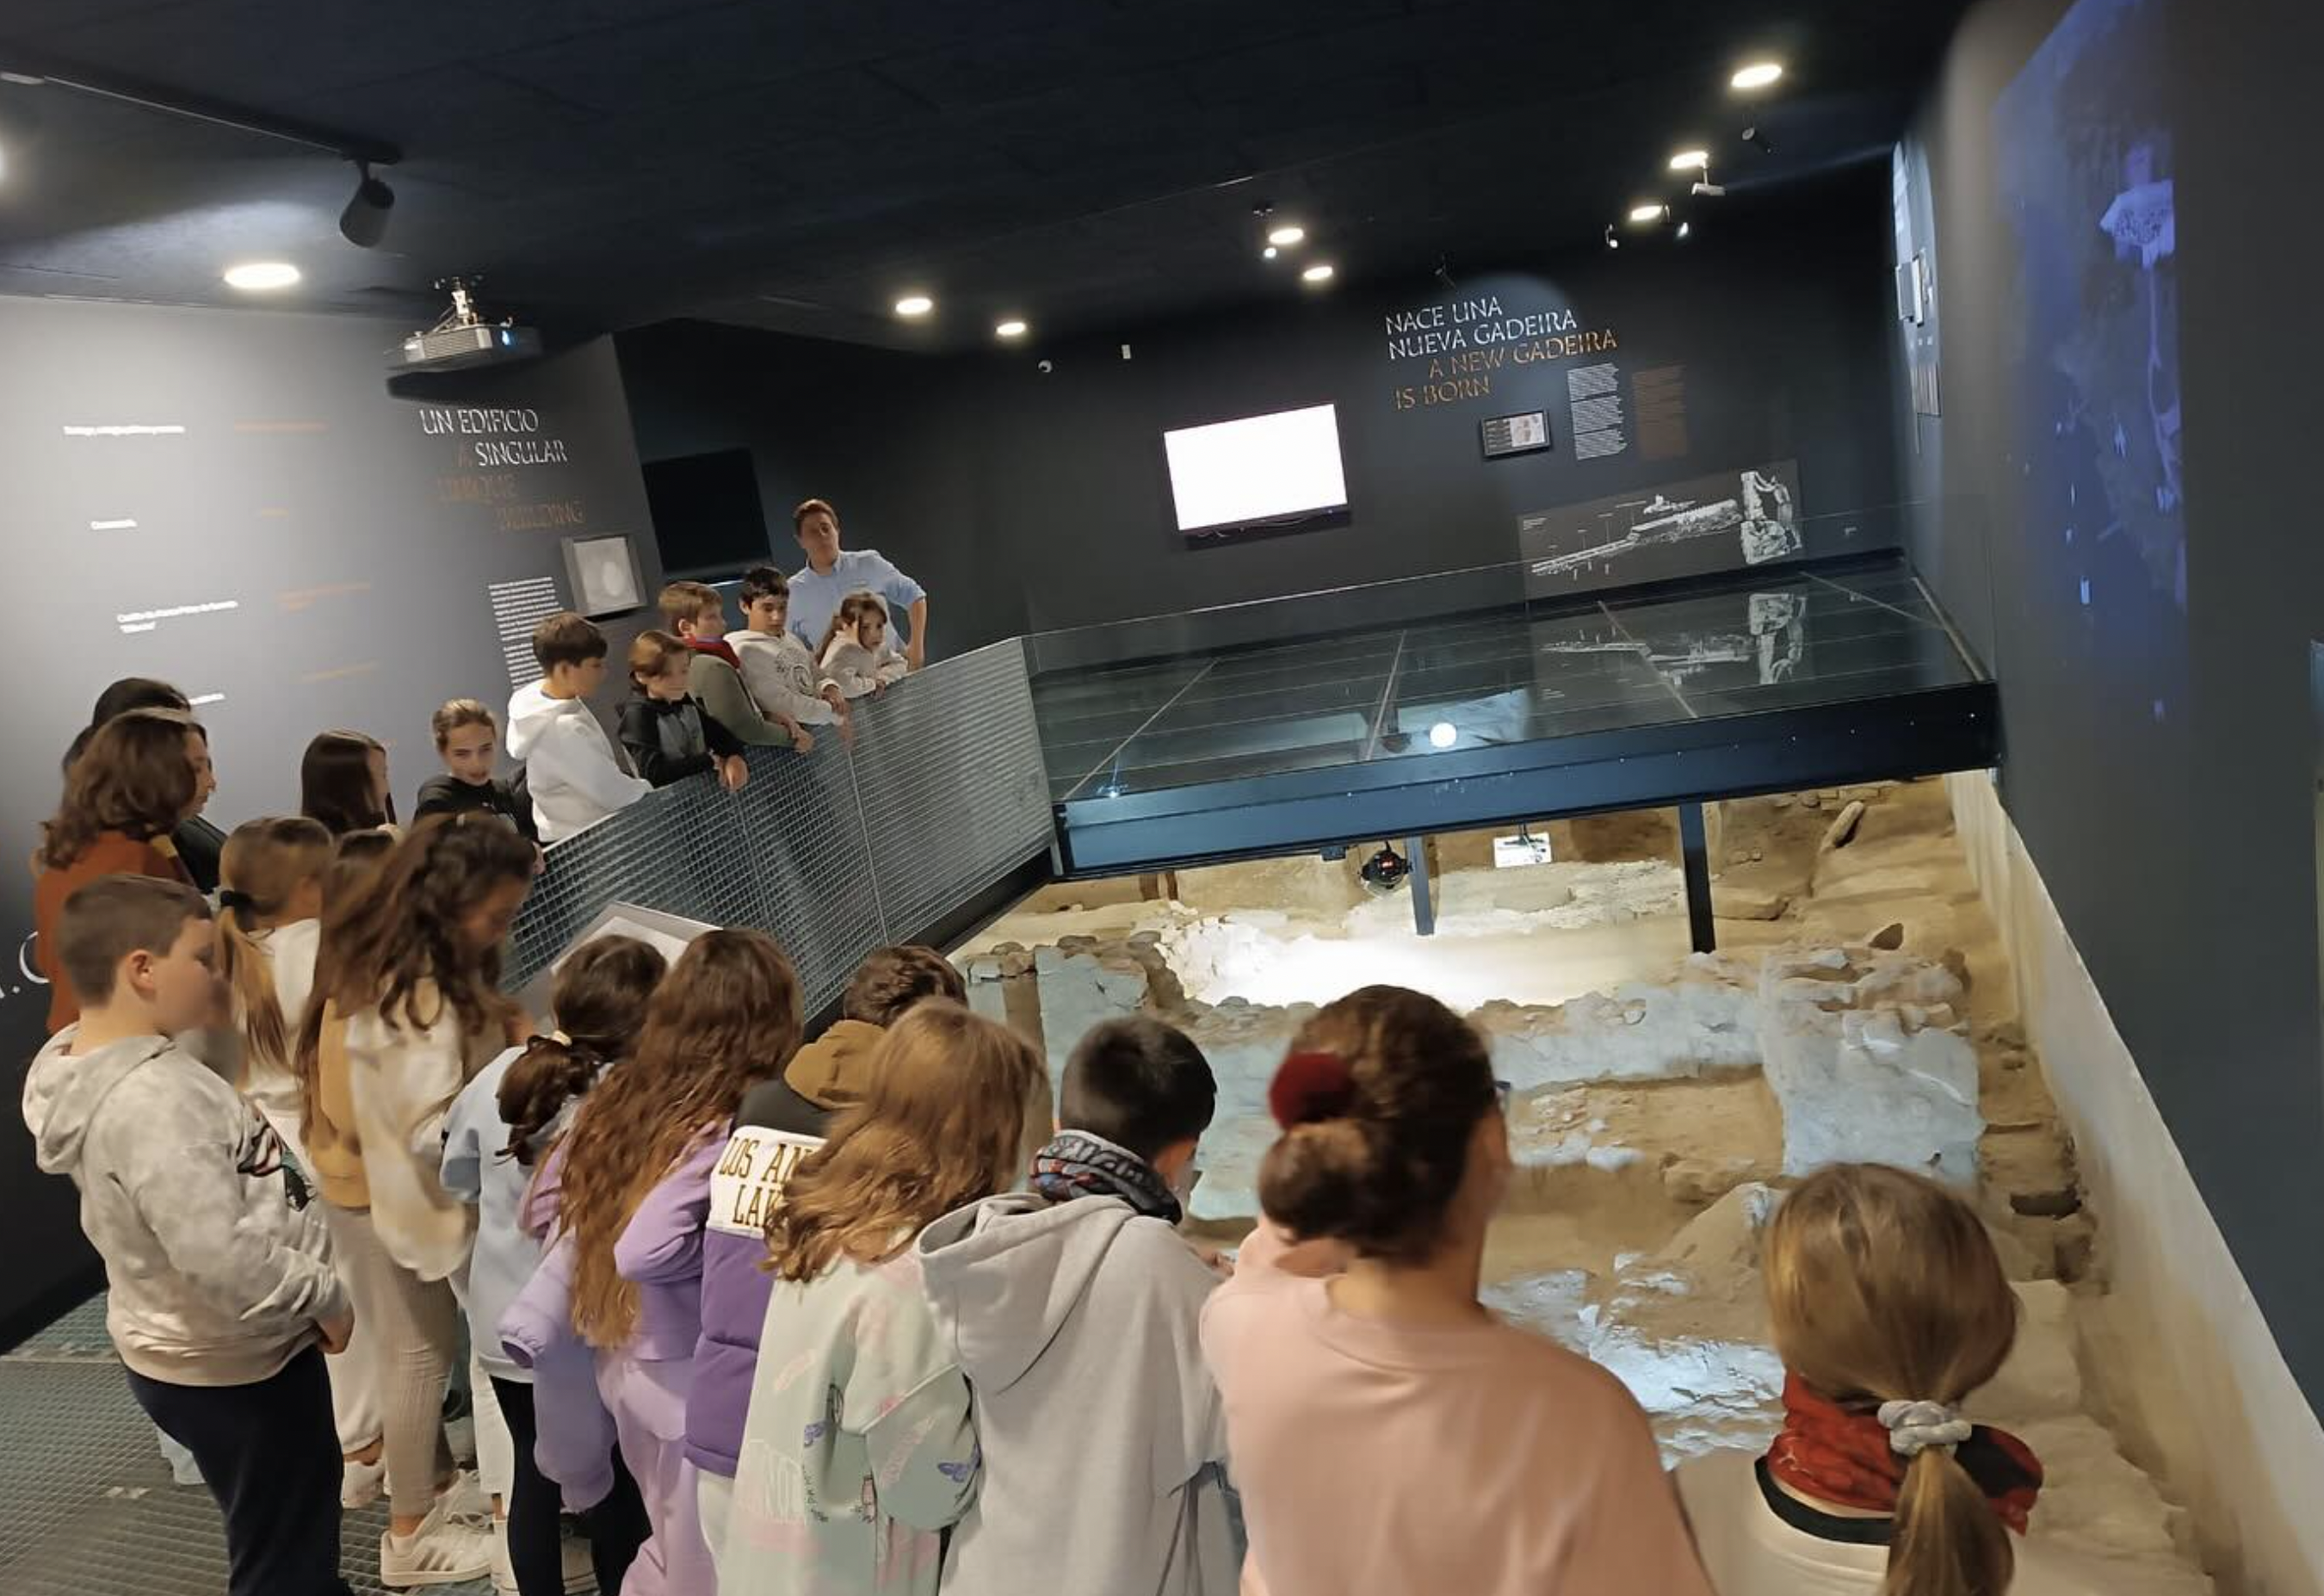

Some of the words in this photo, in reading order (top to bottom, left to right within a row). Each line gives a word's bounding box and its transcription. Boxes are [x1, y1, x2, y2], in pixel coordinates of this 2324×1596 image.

[1385, 305, 1445, 335] NACE
[1452, 297, 1503, 324] UNA
[1388, 329, 1467, 360] NUEVA
[1474, 309, 1578, 344] GADEIRA
[1429, 358, 1443, 379] A
[1451, 347, 1506, 375] NEW
[1512, 329, 1618, 364] GADEIRA
[1394, 388, 1416, 411] IS
[1424, 376, 1490, 405] BORN
[418, 409, 454, 435] UN
[457, 408, 540, 434] EDIFICIO
[474, 439, 568, 467] SINGULAR
[719, 1136, 761, 1179] LOS
